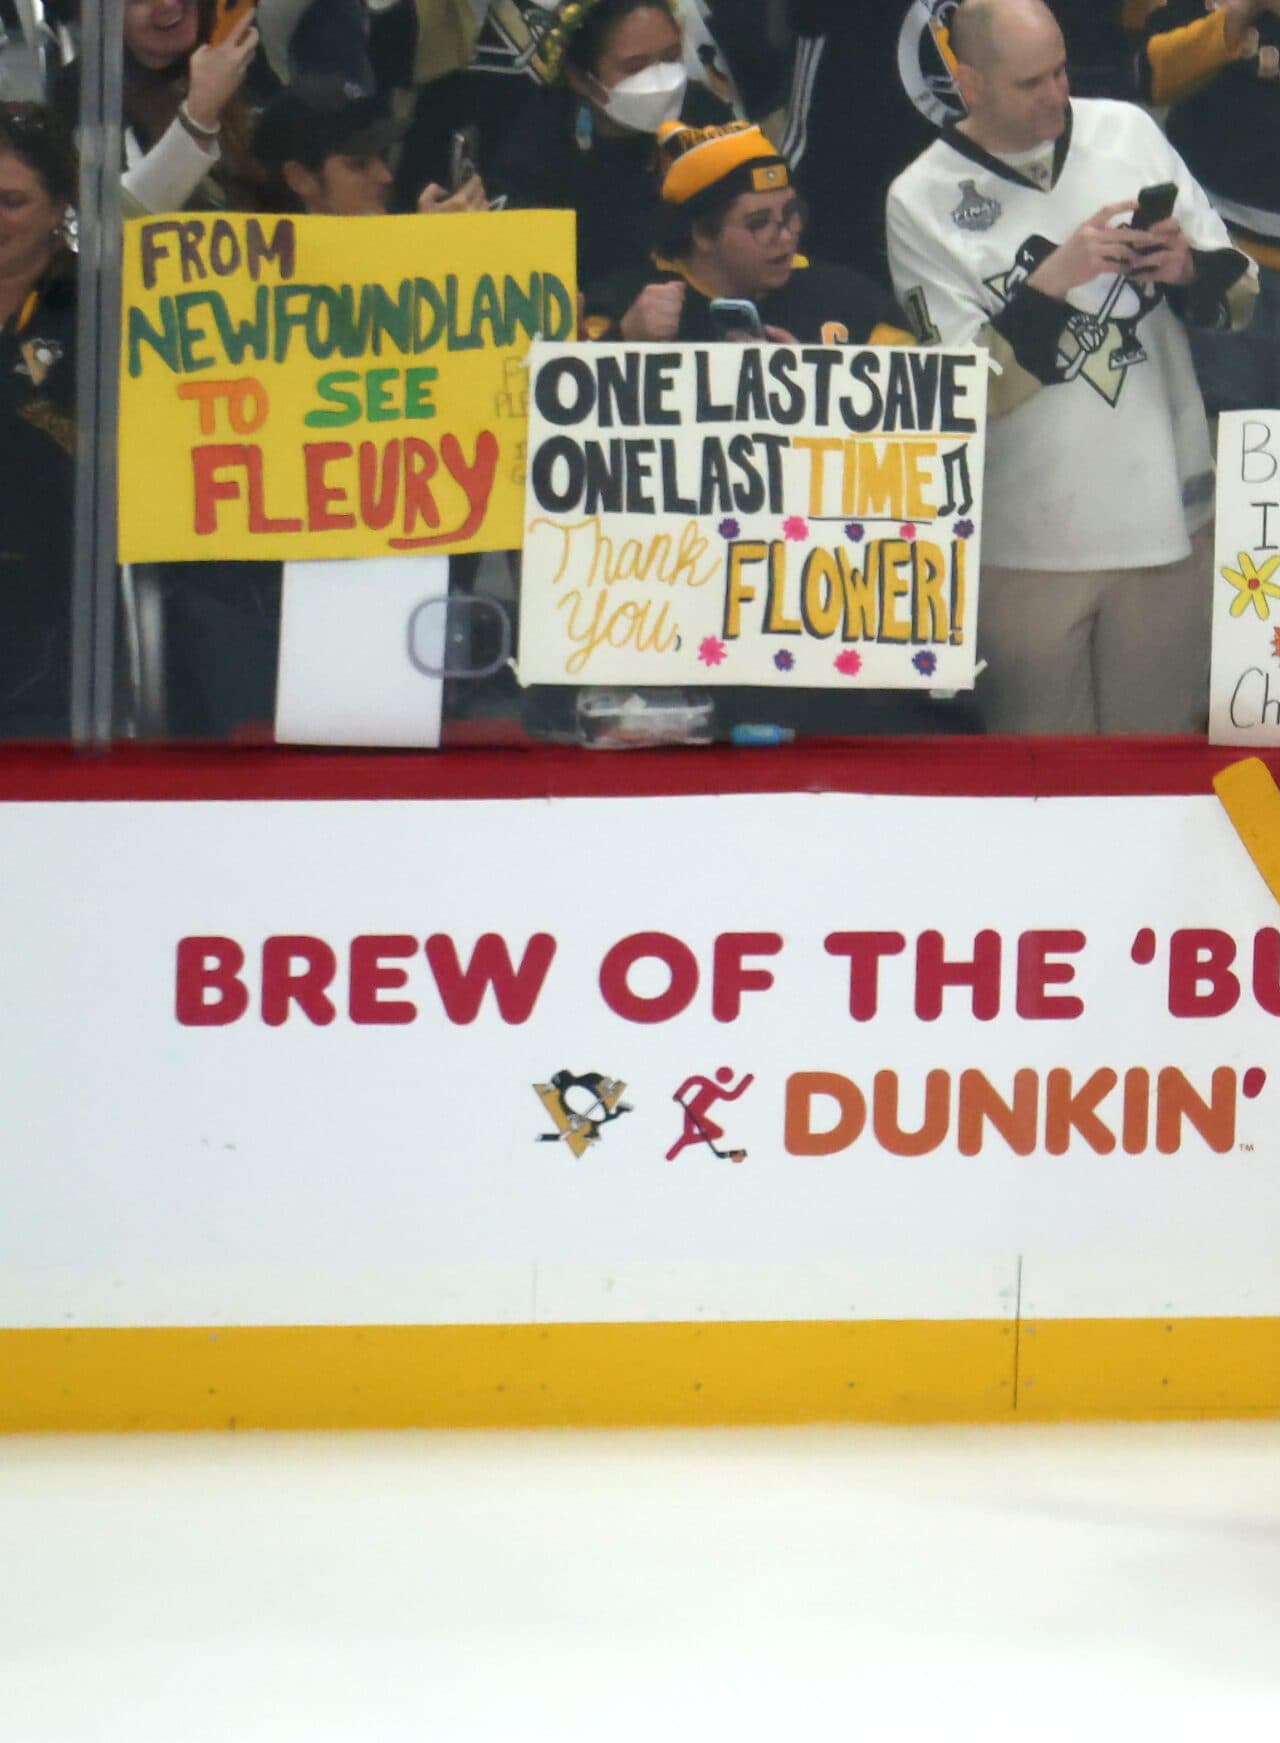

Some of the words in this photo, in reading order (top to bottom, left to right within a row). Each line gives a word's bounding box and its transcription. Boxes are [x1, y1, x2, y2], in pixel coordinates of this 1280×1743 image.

[141, 218, 295, 290] FROM
[128, 271, 574, 378] NEWFOUNDLAND
[176, 377, 269, 436] TO
[304, 367, 439, 428] SEE
[534, 353, 683, 427] ONE
[695, 348, 844, 426] LAST
[839, 351, 977, 433] SAVE
[191, 430, 500, 549] FLEURY
[531, 434, 656, 515] ONE
[660, 433, 790, 515] LAST
[793, 437, 938, 519] TIME
[529, 515, 722, 588] Thank
[722, 538, 967, 646] FLOWER!
[175, 931, 557, 1027] BREW
[599, 931, 784, 1024] OF
[824, 927, 1086, 1023] THE
[784, 1065, 1267, 1158] DUNKIN'
